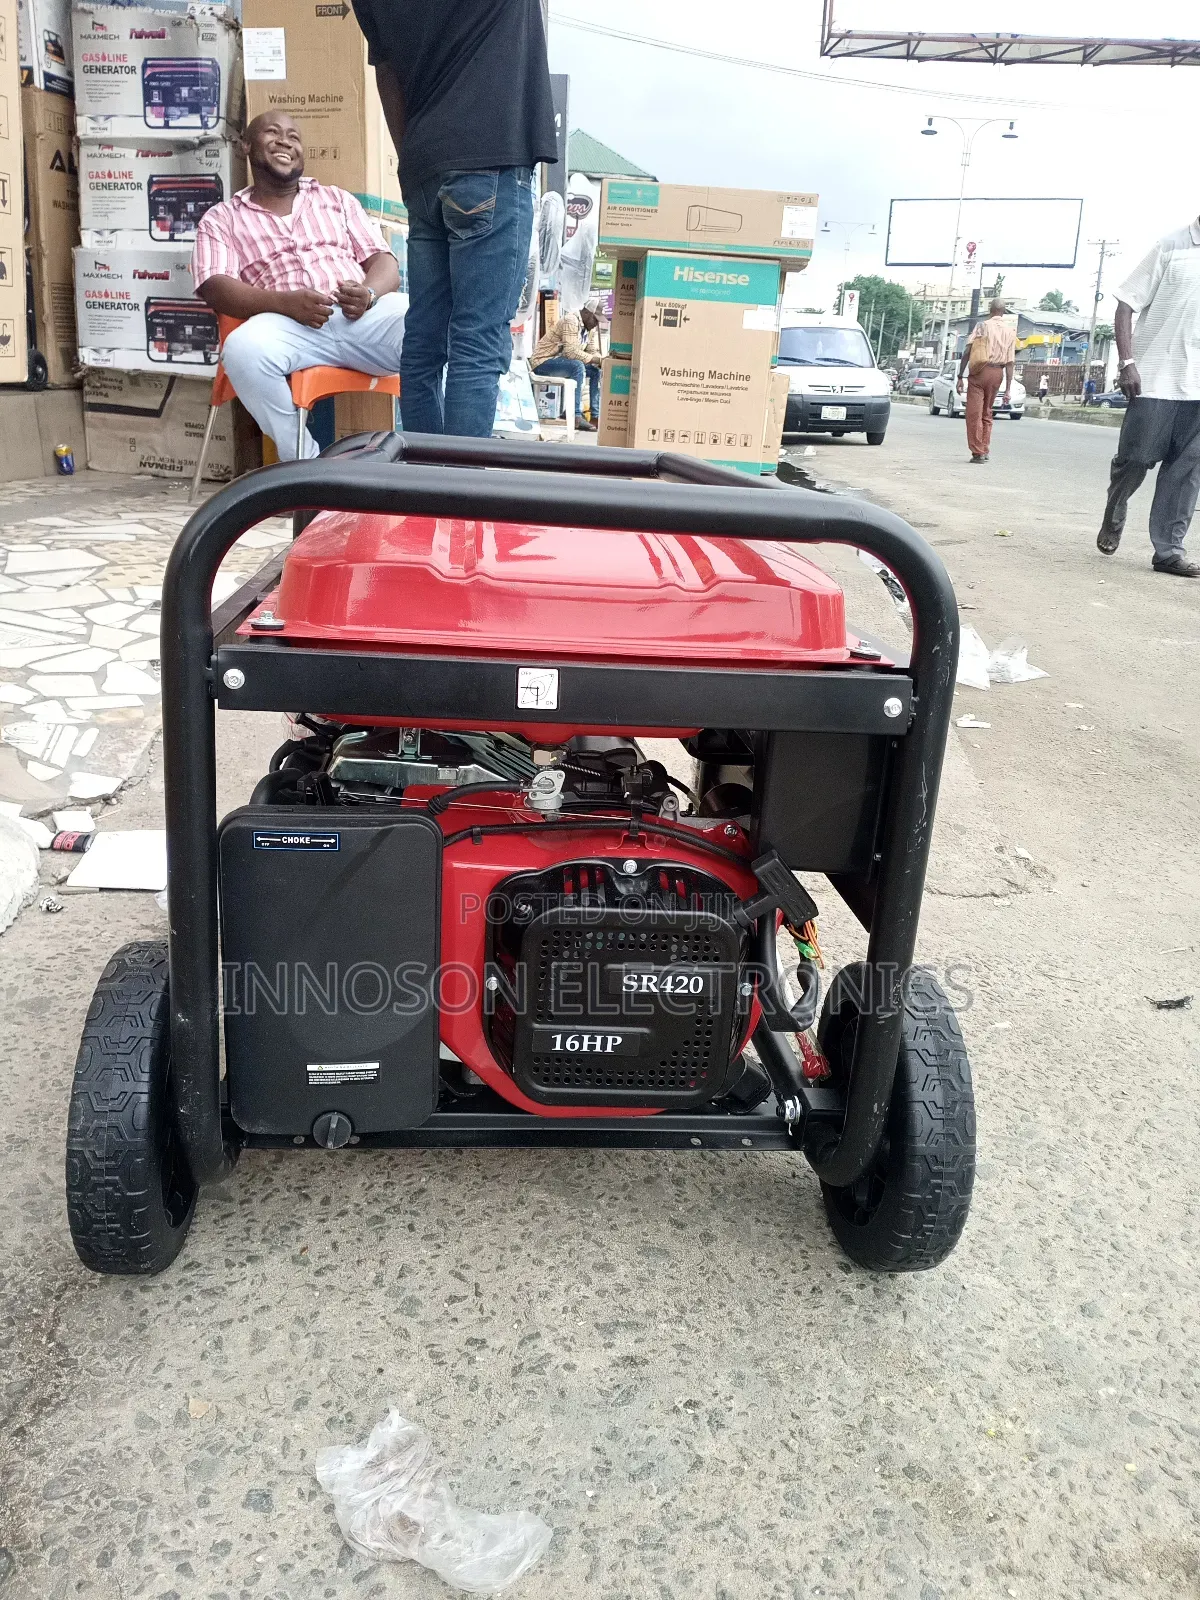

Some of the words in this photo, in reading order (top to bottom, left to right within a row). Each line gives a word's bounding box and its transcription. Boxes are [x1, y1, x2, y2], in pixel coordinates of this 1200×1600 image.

[316, 6, 343, 15] FRONT
[82, 65, 137, 75] GENERATOR
[268, 95, 306, 105] Washing
[308, 94, 344, 103] Machine
[89, 181, 143, 191] GENERATOR
[618, 206, 659, 214] CONDITIONER
[83, 272, 123, 280] MAXMECH
[673, 266, 750, 286] Hisense
[85, 300, 141, 312] GENERATOR
[660, 366, 705, 381] Washing
[708, 370, 751, 382] Machine
[139, 461, 184, 473] FIRMAN
[281, 836, 311, 844] CHOKE
[621, 974, 704, 995] SR420
[550, 1033, 623, 1053] 16HP
